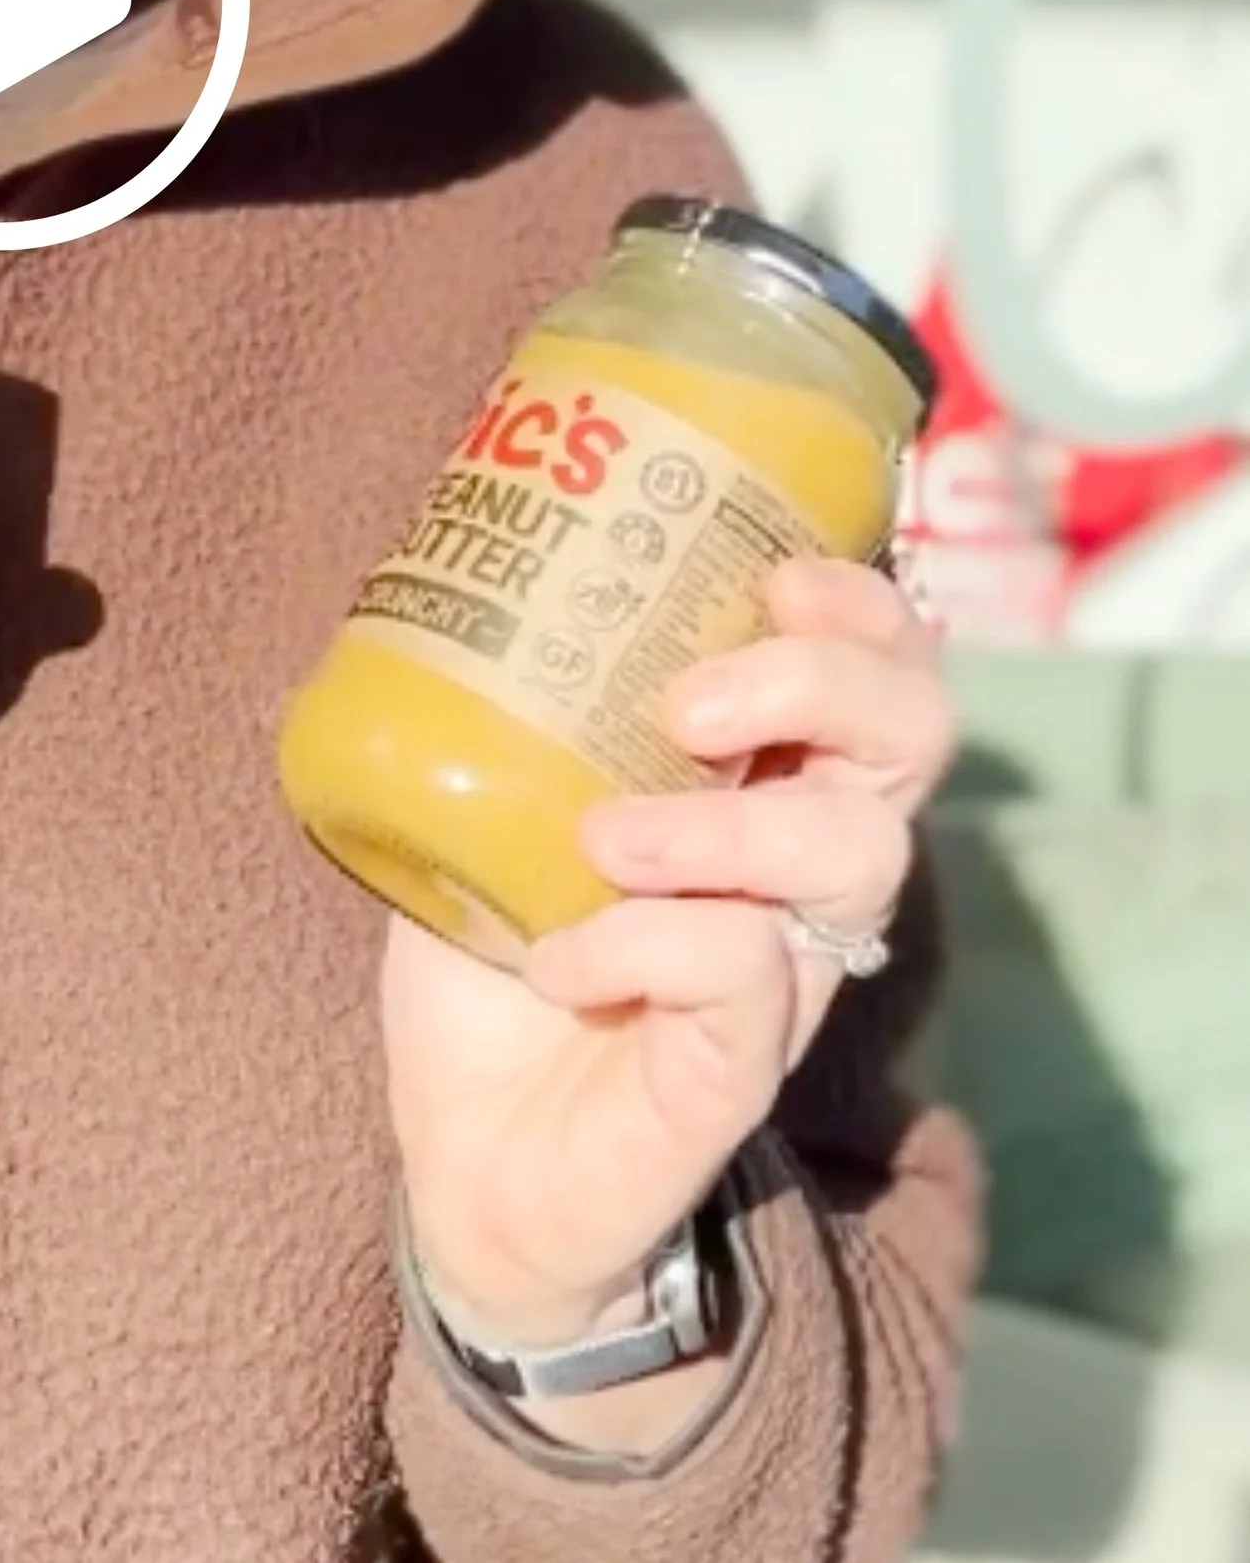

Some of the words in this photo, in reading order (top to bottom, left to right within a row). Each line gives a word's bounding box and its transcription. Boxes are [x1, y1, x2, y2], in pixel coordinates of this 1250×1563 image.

[428, 472, 591, 553] EANUT
[395, 516, 547, 603] UTTER
[539, 640, 587, 677] GF
